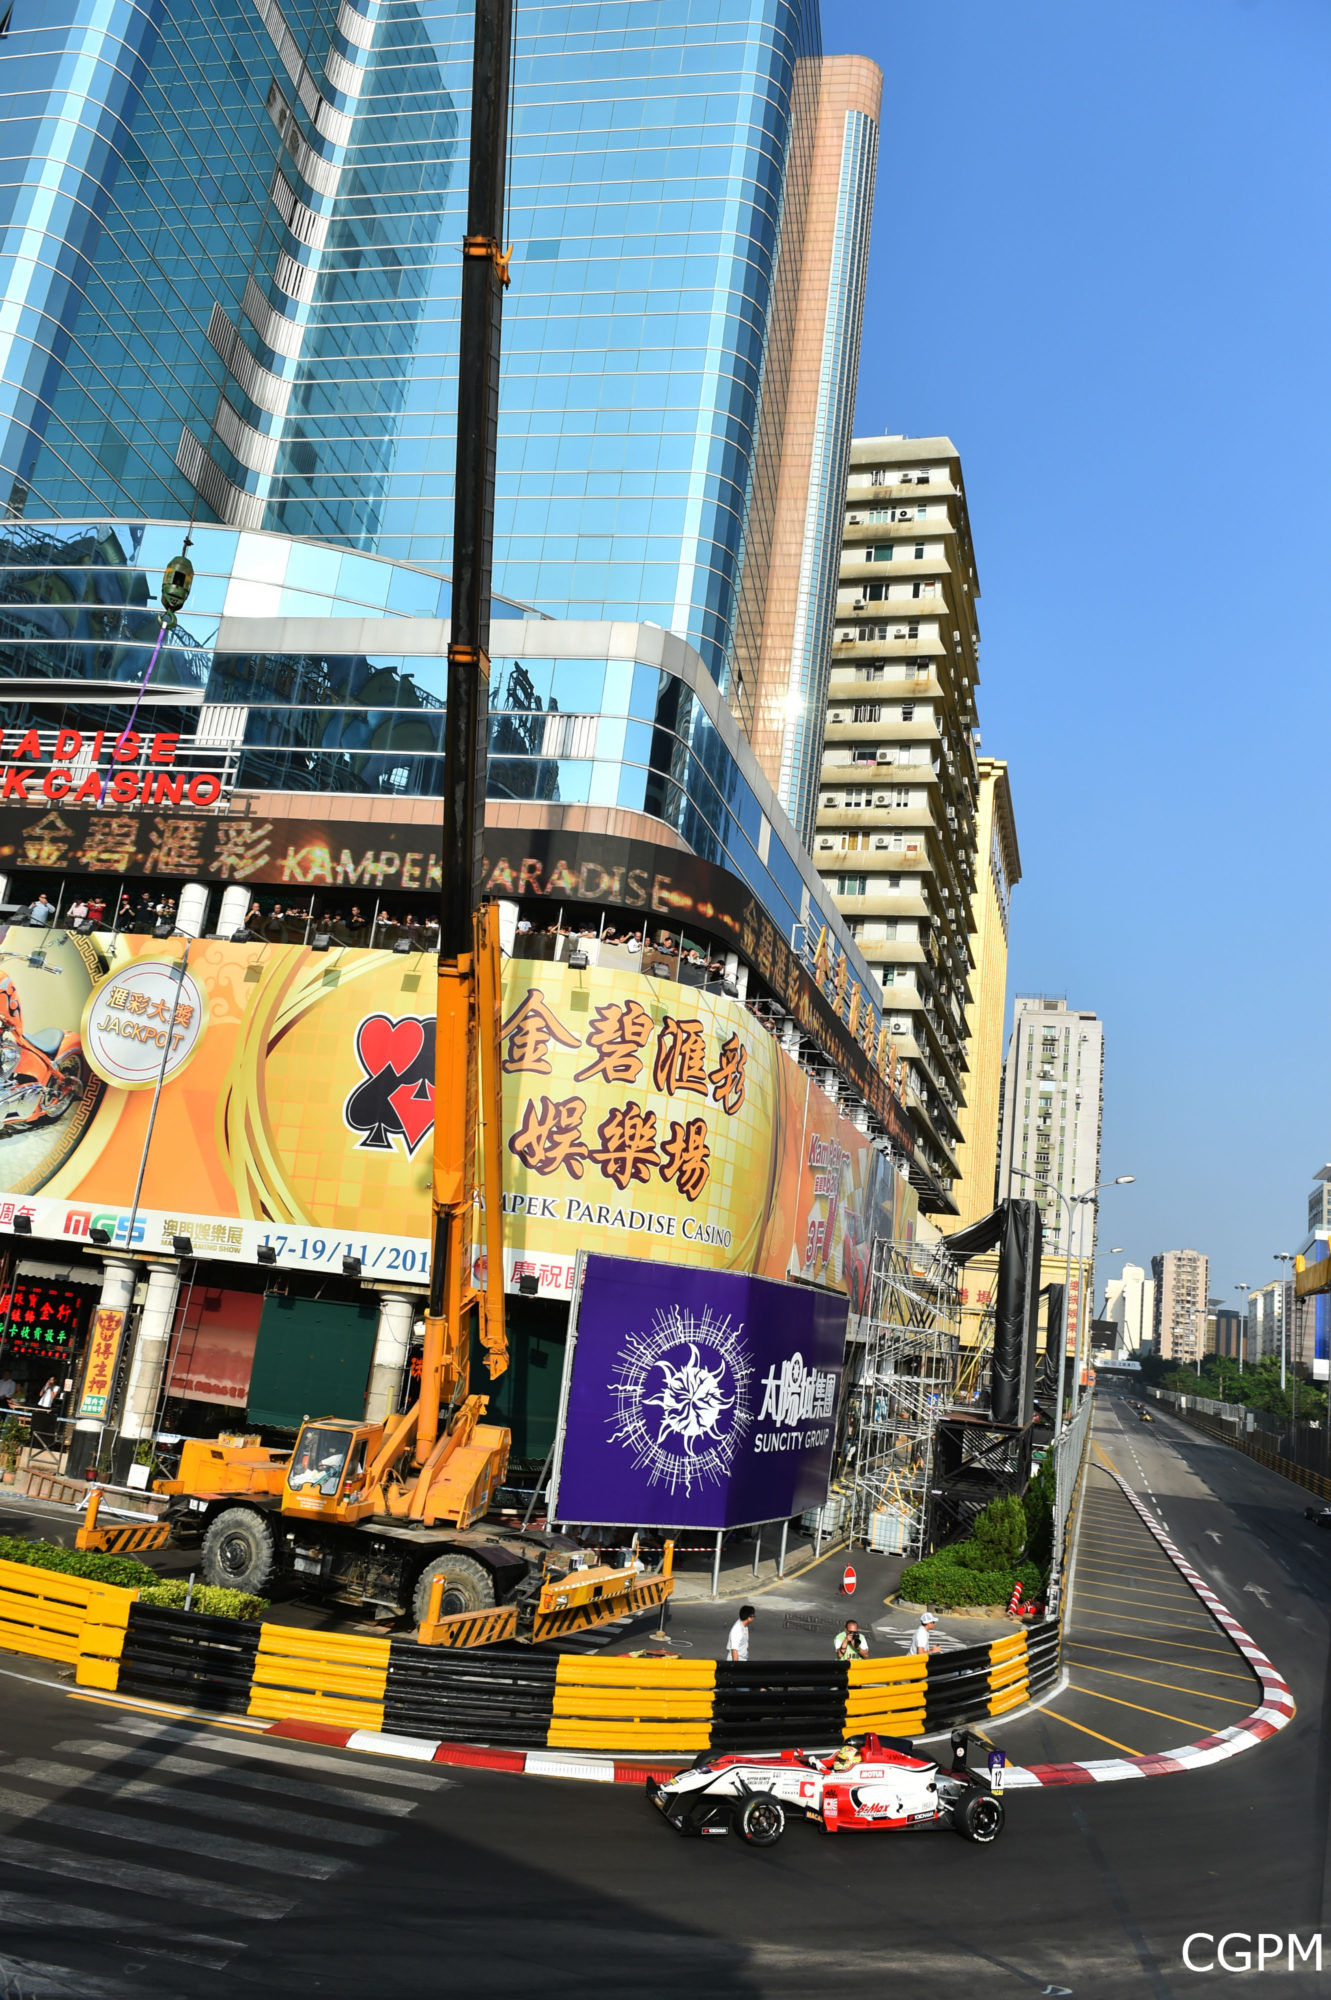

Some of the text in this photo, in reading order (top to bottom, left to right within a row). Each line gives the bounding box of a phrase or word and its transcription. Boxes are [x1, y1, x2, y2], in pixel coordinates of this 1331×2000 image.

[0, 728, 180, 763] ADISE
[0, 768, 221, 806] K CASINO
[482, 851, 674, 914] ARADISE
[97, 1014, 185, 1051] JACKPOT
[63, 1209, 148, 1243] MGS
[565, 1196, 677, 1237] PARADISE
[681, 1217, 733, 1250] CASINO
[261, 1233, 432, 1275] 17-19/11/201
[754, 1428, 830, 1453] SUNCITY GROUP
[994, 1770, 1003, 1787] 12
